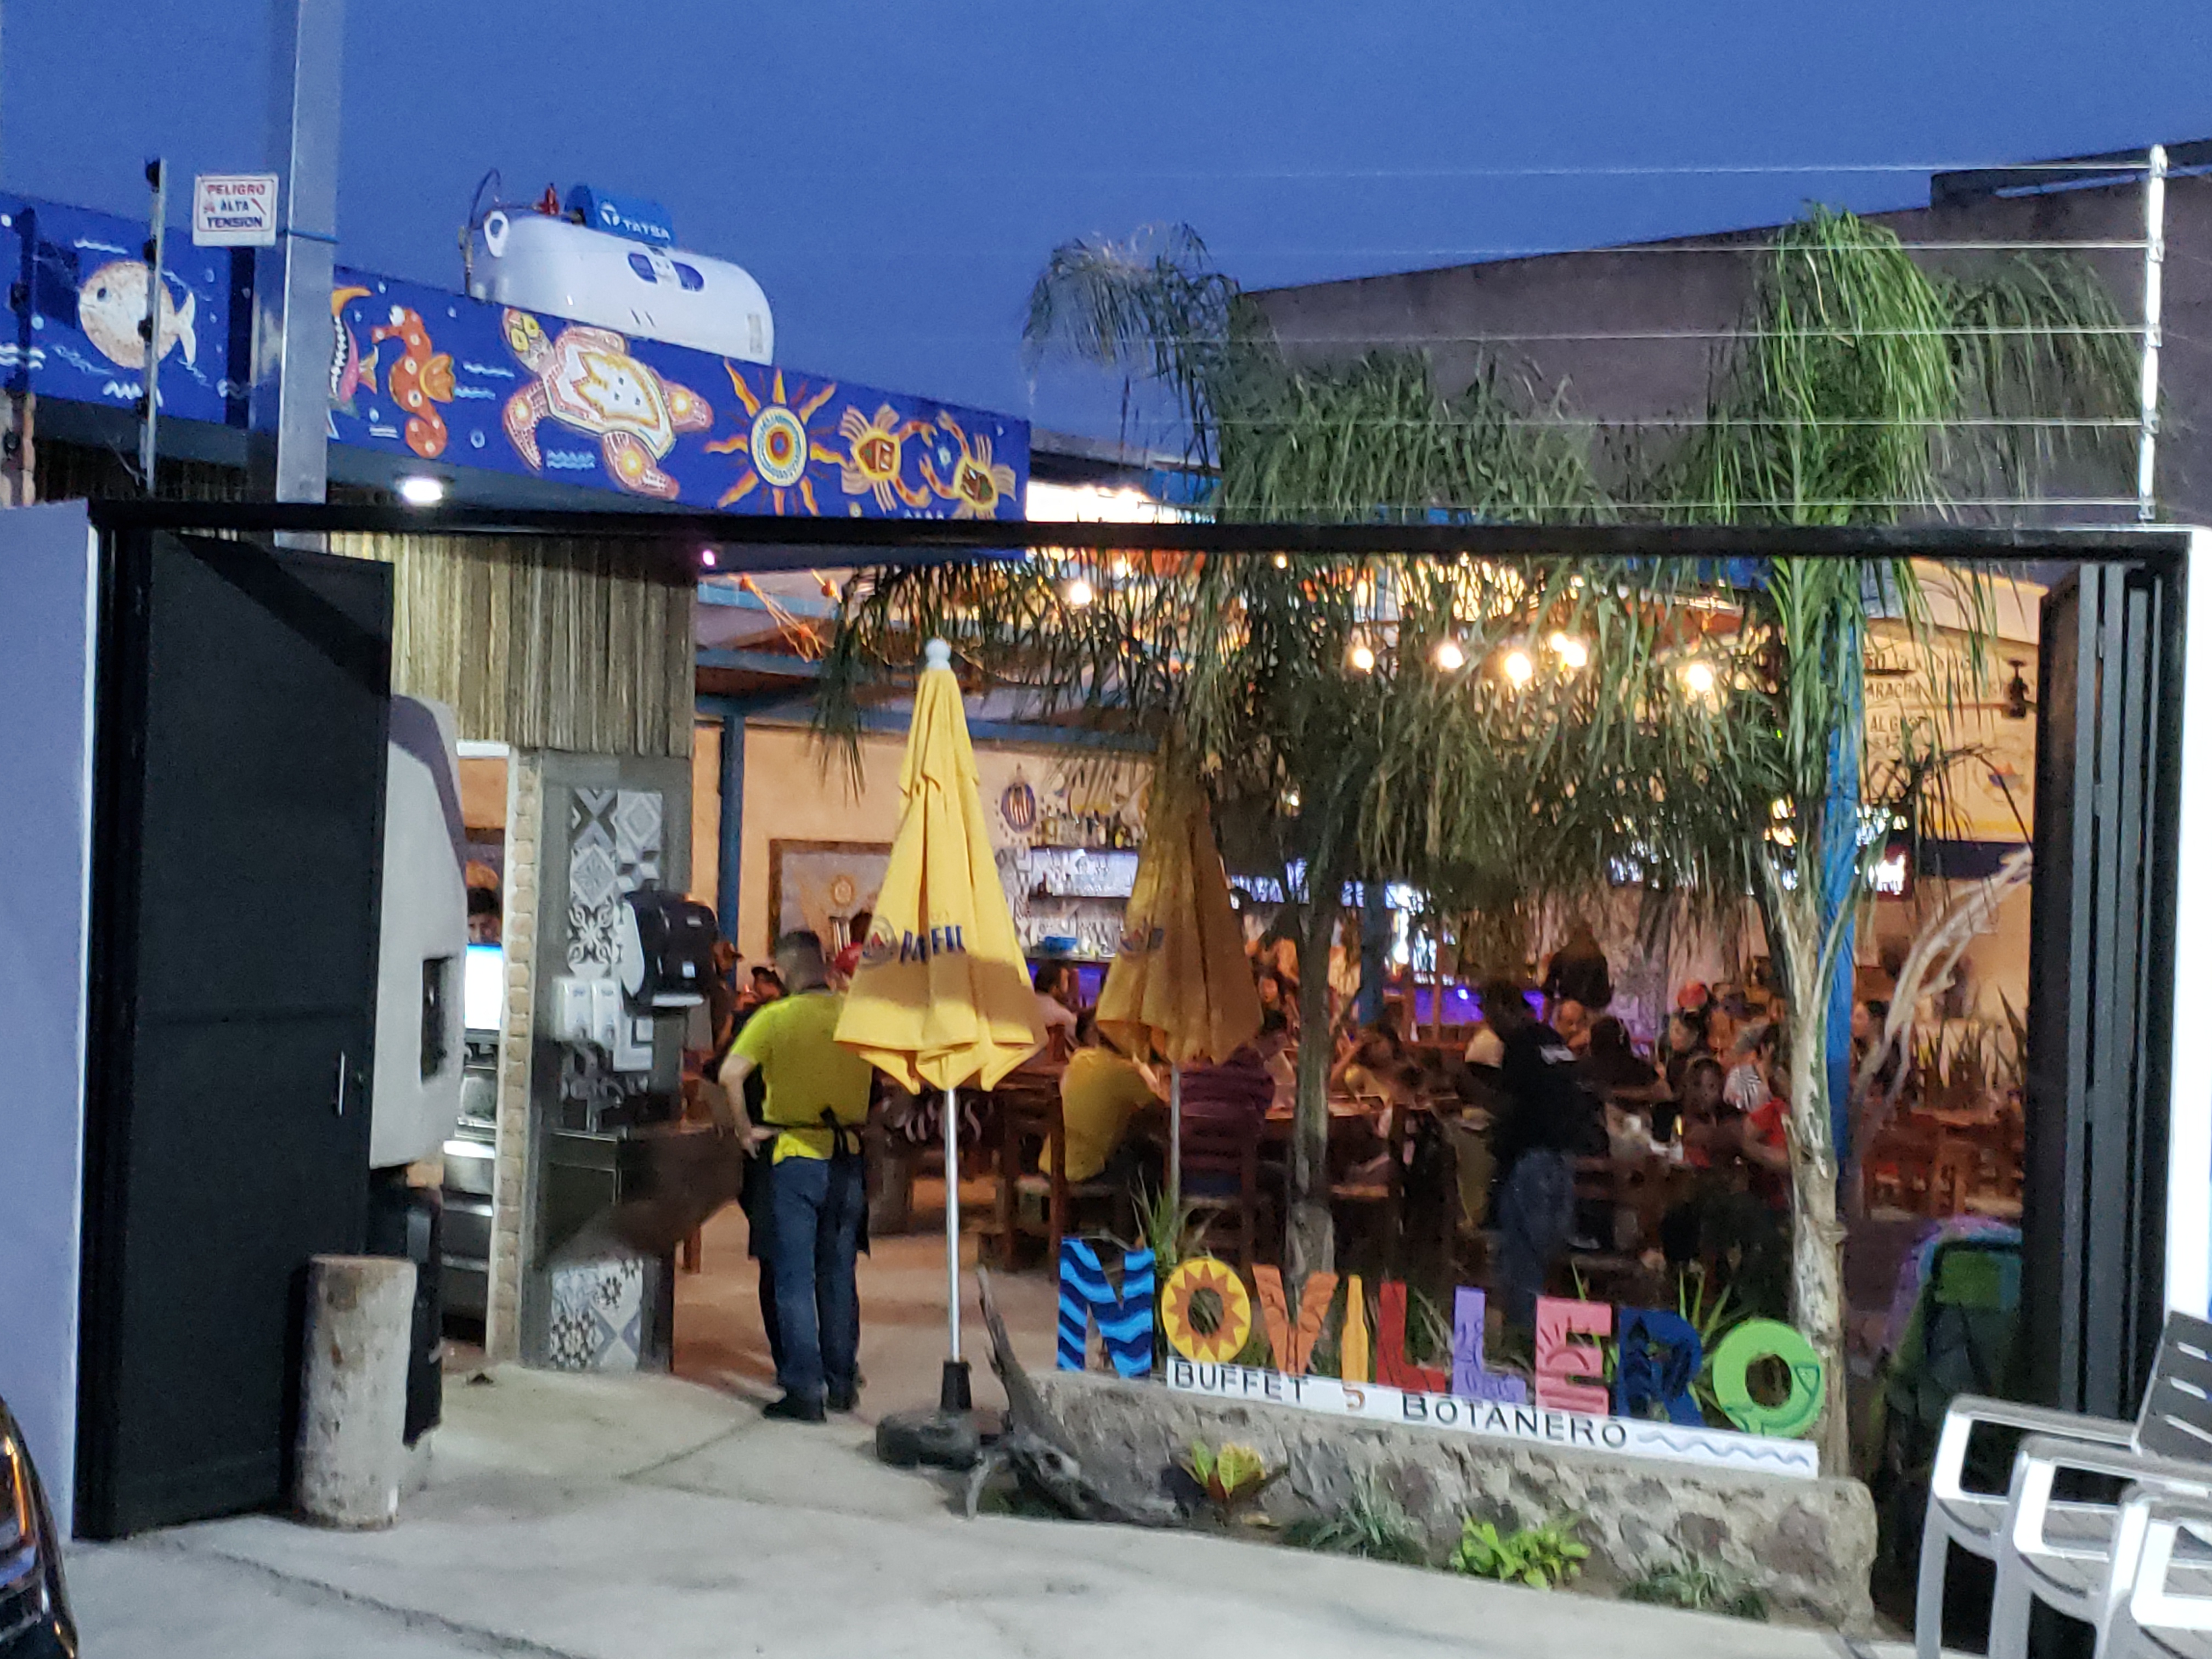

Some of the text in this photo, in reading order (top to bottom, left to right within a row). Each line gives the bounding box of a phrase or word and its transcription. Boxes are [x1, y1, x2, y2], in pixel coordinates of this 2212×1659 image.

[207, 184, 266, 195] PELIGRO
[221, 199, 249, 211] ALTA
[207, 216, 263, 228] TENSION
[1057, 1236, 1825, 1439] NOVILLERO
[1173, 1361, 1310, 1404] BUFFET
[1402, 1392, 1627, 1449] BOTANERO
